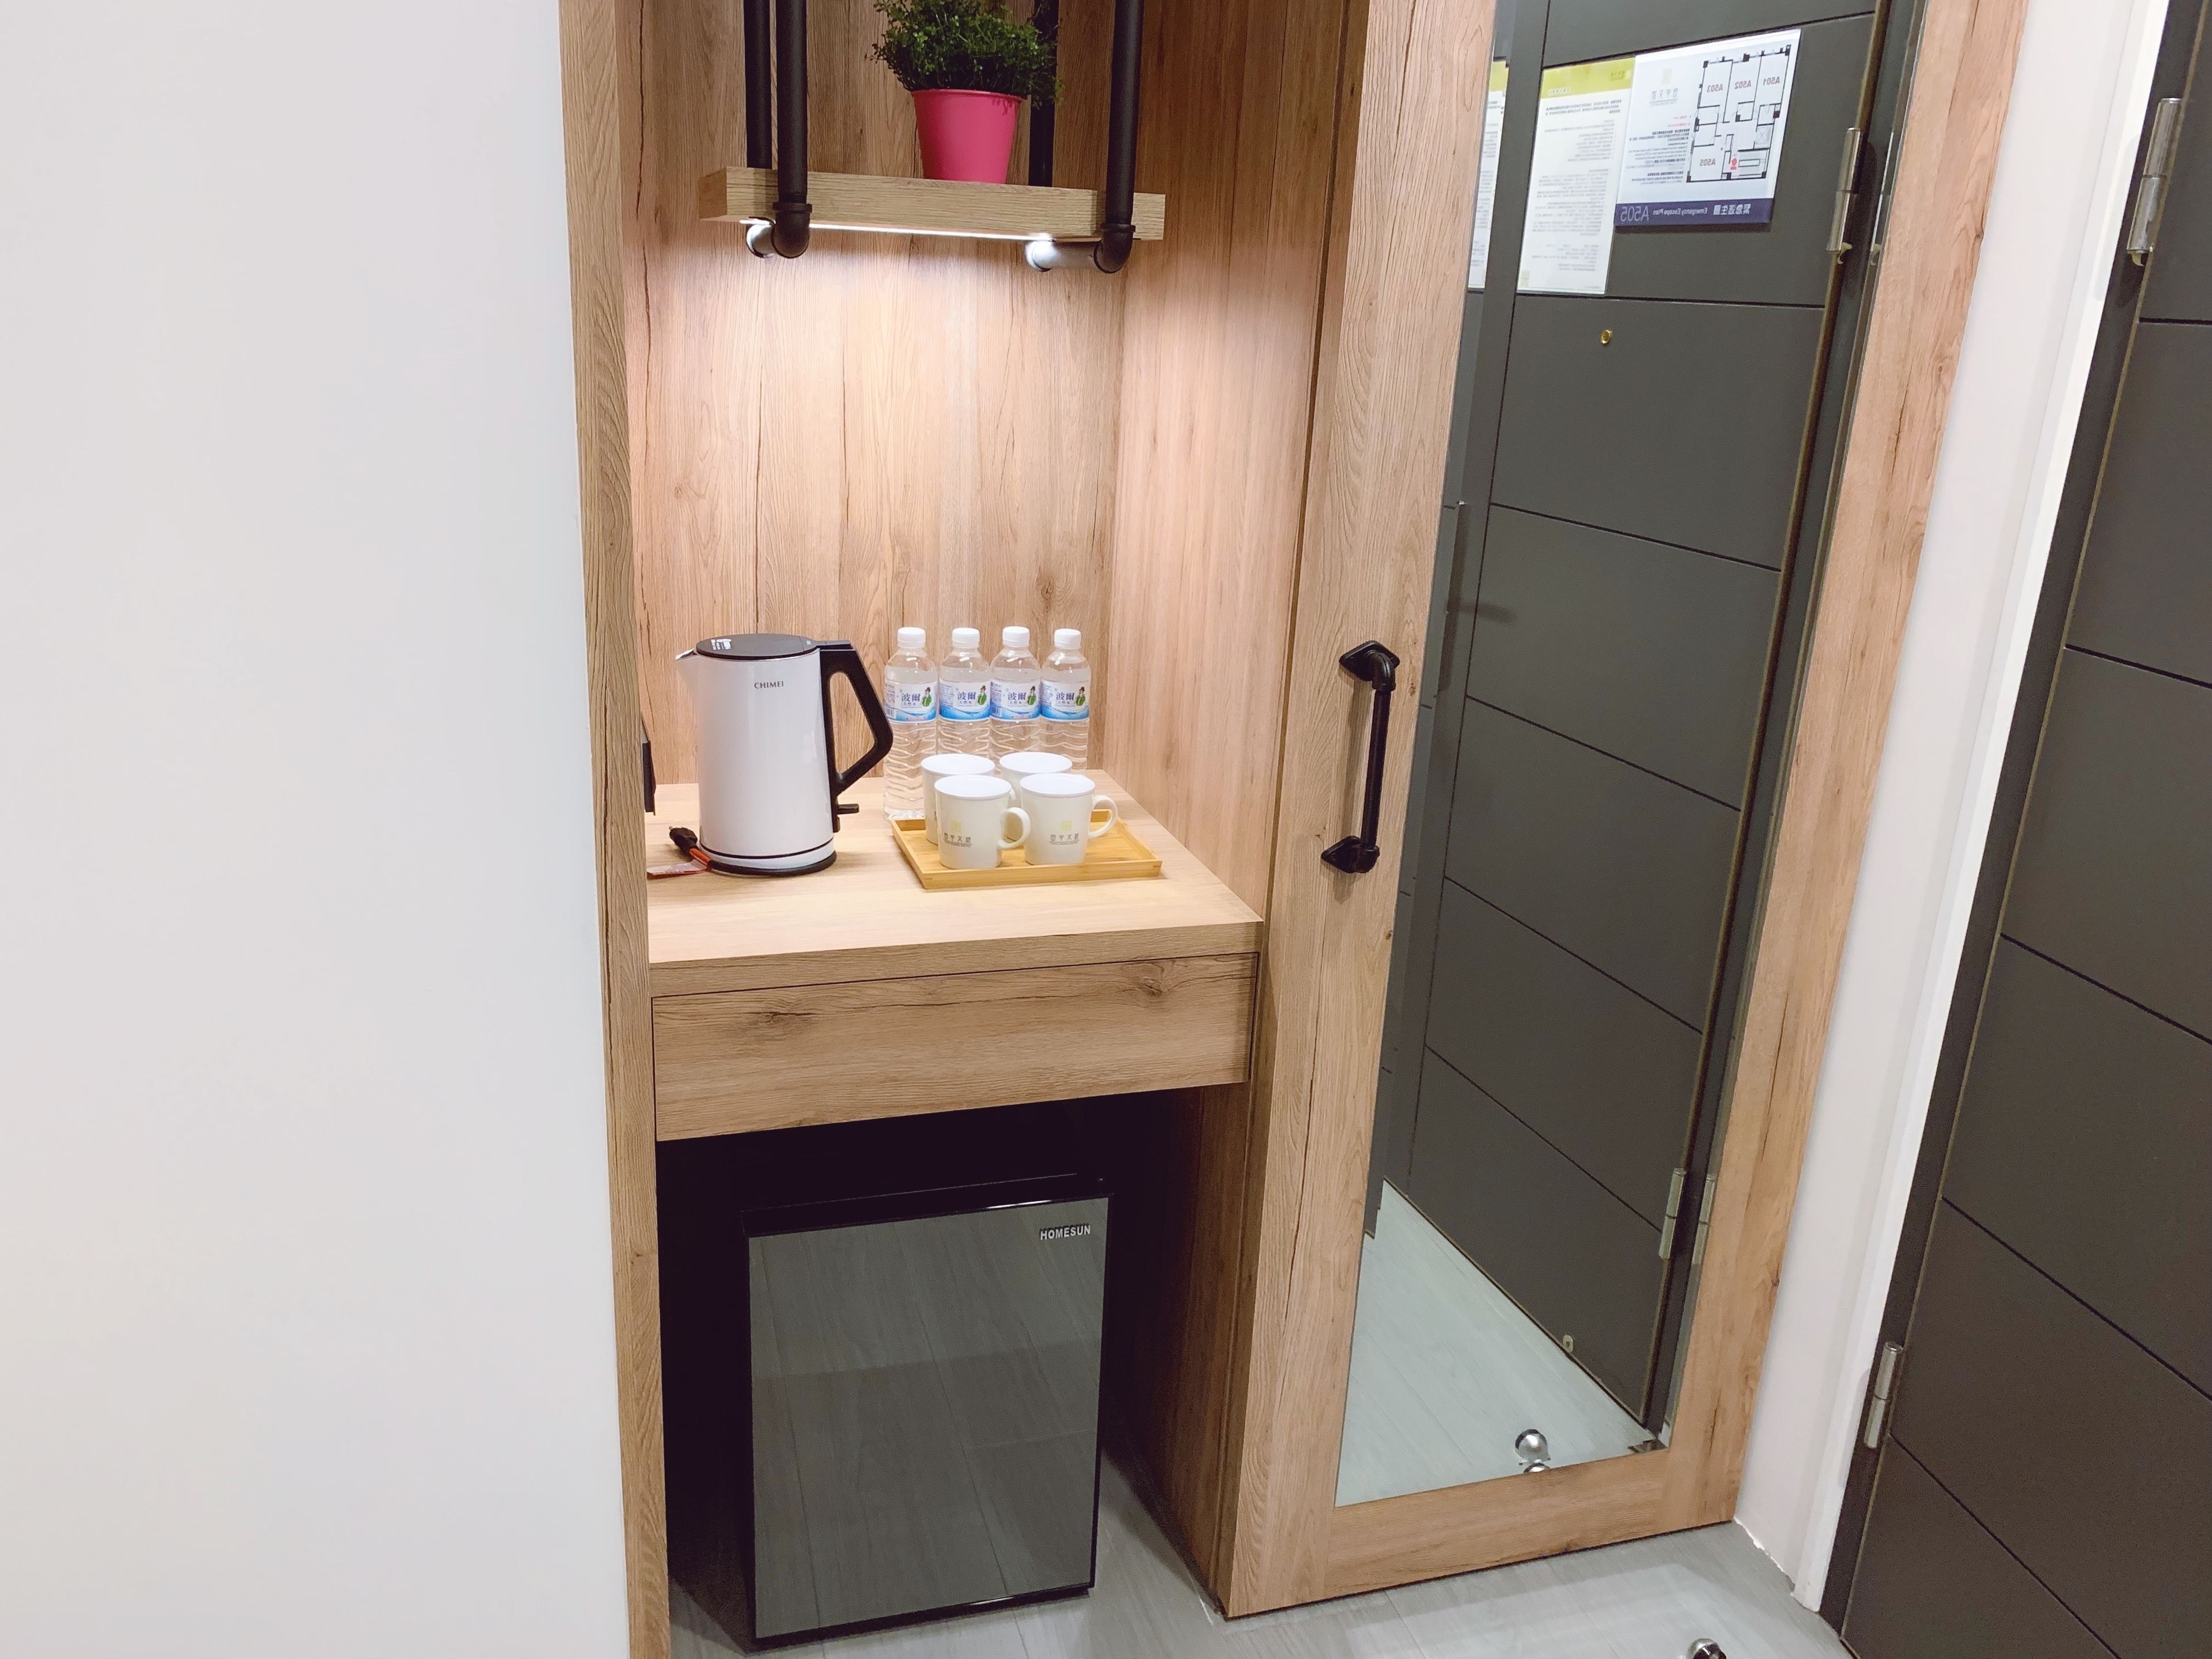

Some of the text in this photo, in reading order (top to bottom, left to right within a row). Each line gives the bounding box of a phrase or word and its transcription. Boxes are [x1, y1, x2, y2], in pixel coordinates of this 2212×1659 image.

[754, 681, 784, 689] CHIMEI
[901, 692, 921, 702] 波爾
[957, 691, 976, 700] 波爾
[1007, 692, 1027, 700] 波爾
[1056, 692, 1075, 700] 波爾
[1040, 1225, 1091, 1240] HOMESUN
